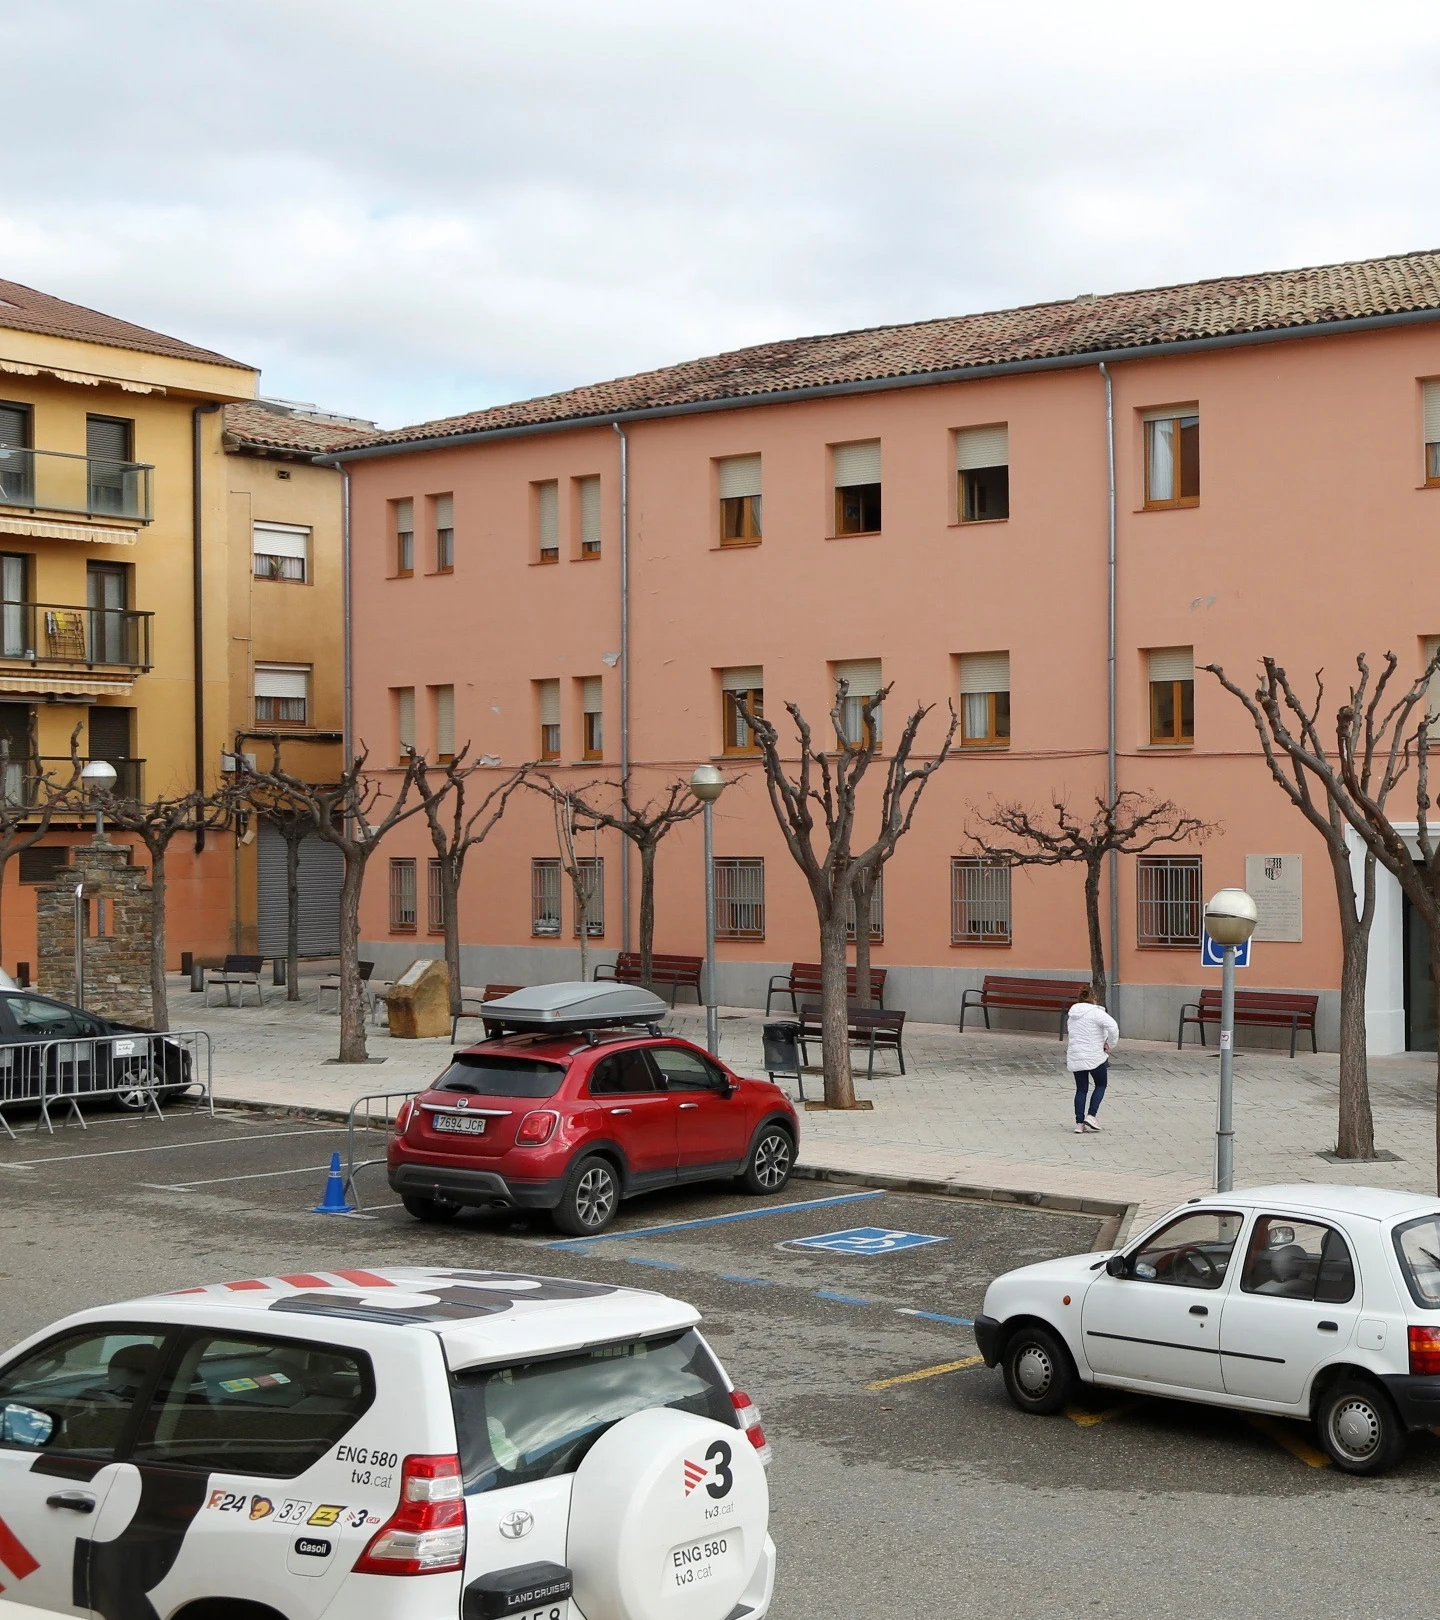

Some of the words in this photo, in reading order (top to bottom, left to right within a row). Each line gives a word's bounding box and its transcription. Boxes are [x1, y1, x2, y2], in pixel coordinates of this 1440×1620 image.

[439, 1117, 462, 1128] 7694
[465, 1119, 484, 1131] JCR
[336, 1445, 368, 1464] ENG
[370, 1450, 398, 1469] 580
[351, 1469, 393, 1489] tv3.cat
[704, 1501, 734, 1520] tv3.cat
[299, 1541, 327, 1554] Gasoil
[673, 1546, 702, 1568] ENG
[704, 1539, 728, 1558] 580
[675, 1563, 713, 1586] tv3.cat
[507, 1592, 534, 1606] LAND
[534, 1581, 570, 1598] CRUISER
